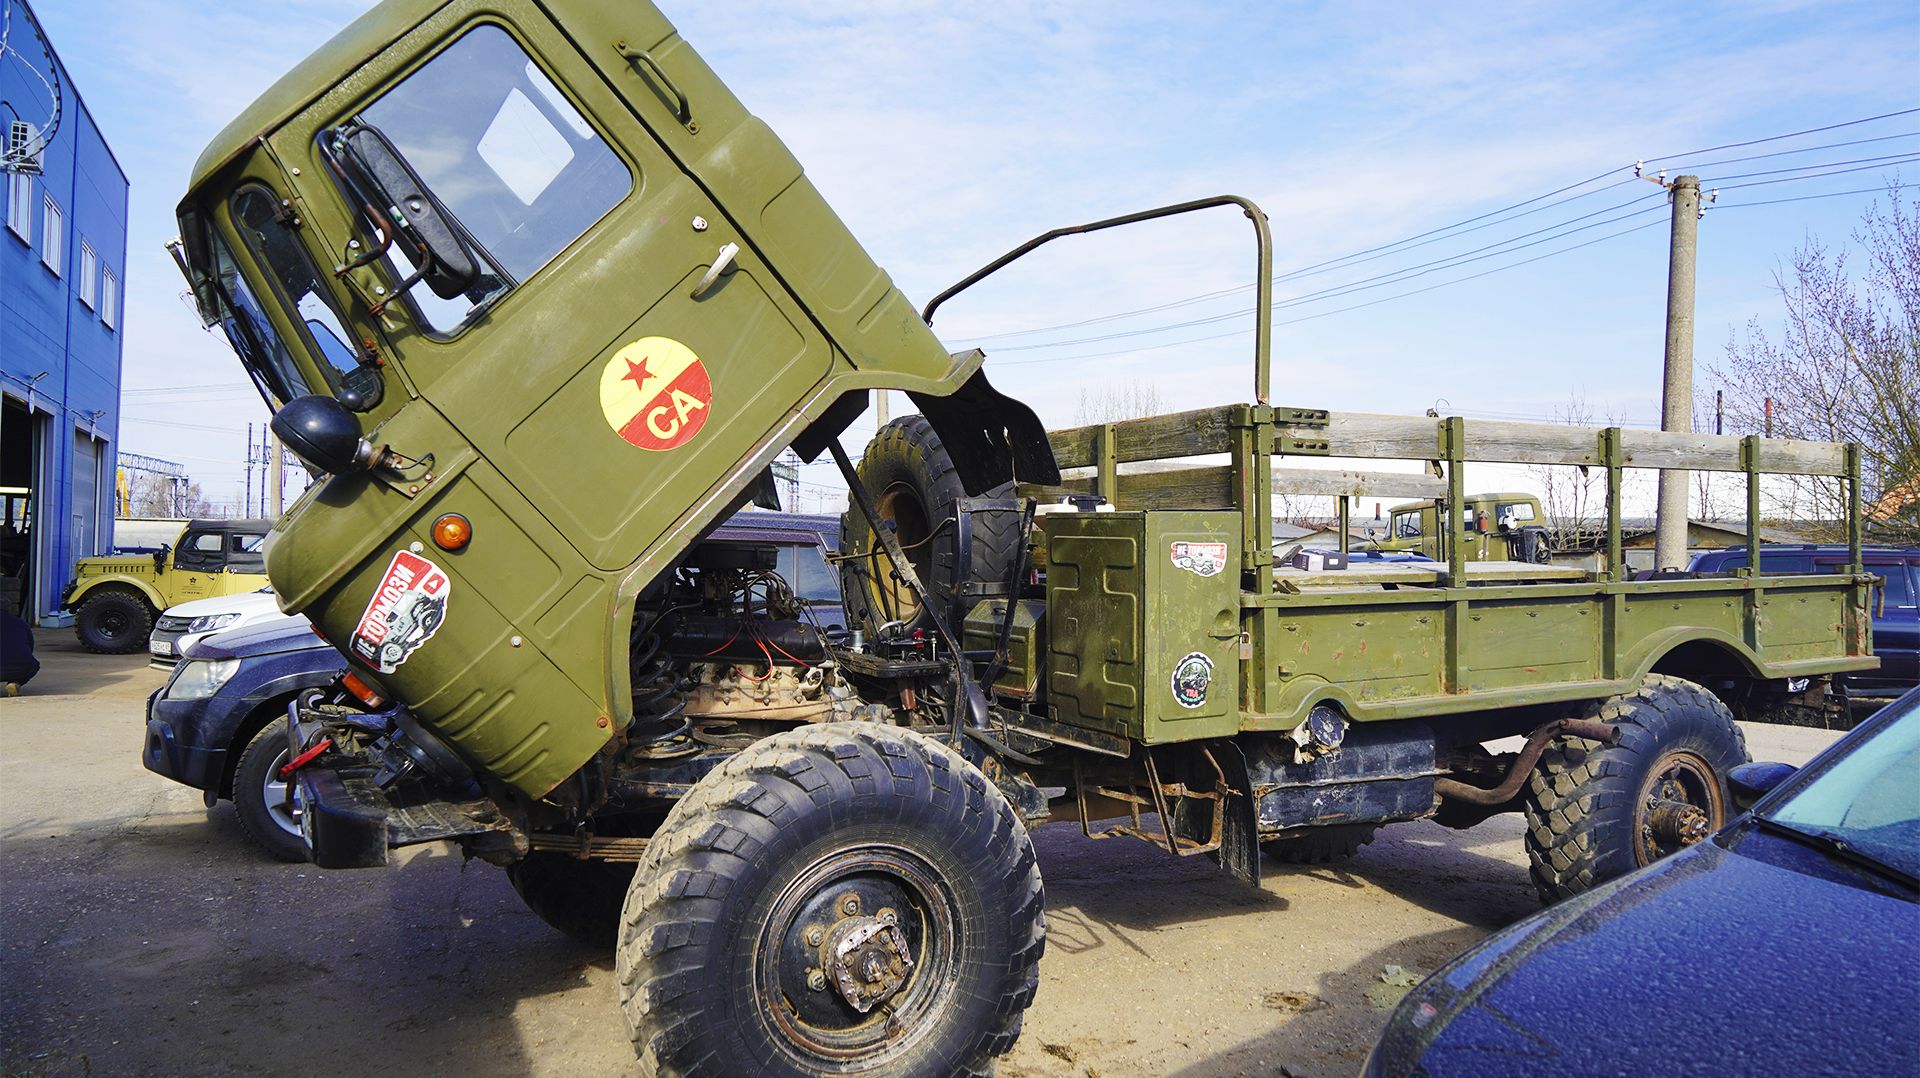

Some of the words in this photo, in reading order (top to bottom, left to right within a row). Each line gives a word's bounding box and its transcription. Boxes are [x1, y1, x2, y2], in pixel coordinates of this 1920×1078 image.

[646, 388, 705, 440] СА
[1177, 545, 1188, 555] НЕ
[362, 563, 416, 644] ТОРМОЗИ
[356, 637, 376, 660] НЕ
